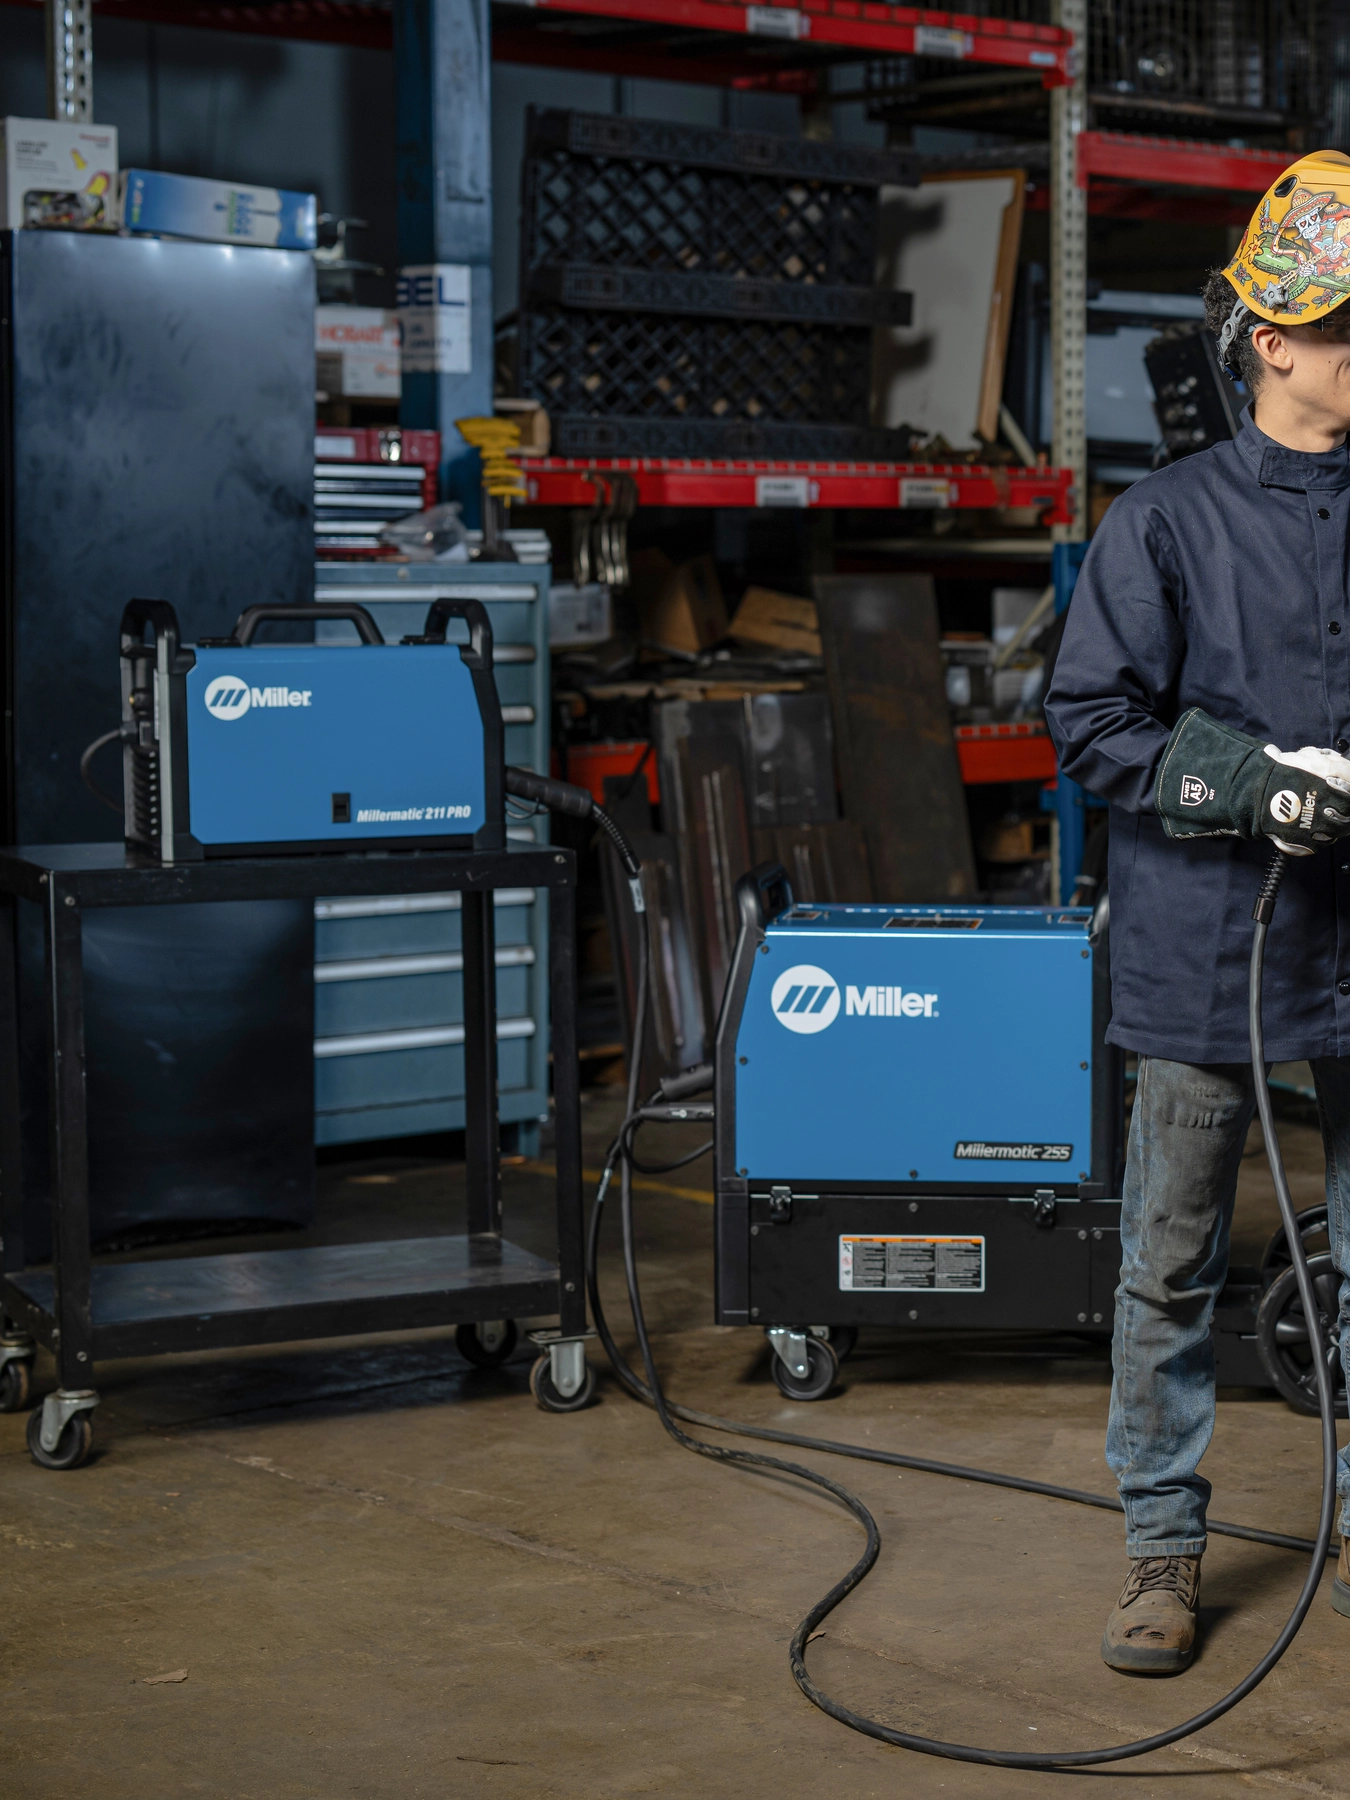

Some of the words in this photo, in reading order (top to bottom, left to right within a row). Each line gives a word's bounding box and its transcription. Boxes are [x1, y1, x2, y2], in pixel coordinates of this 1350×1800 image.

[251, 687, 312, 708] Miller
[1189, 783, 1203, 801] A5
[1208, 788, 1216, 800] CUT
[357, 807, 423, 823] Millermatic
[425, 806, 446, 820] 211
[446, 805, 472, 819] PRO
[1299, 791, 1317, 829] Miller
[845, 985, 939, 1018] Miller
[956, 1143, 1042, 1160] Millermatic
[1041, 1145, 1071, 1160] 255
